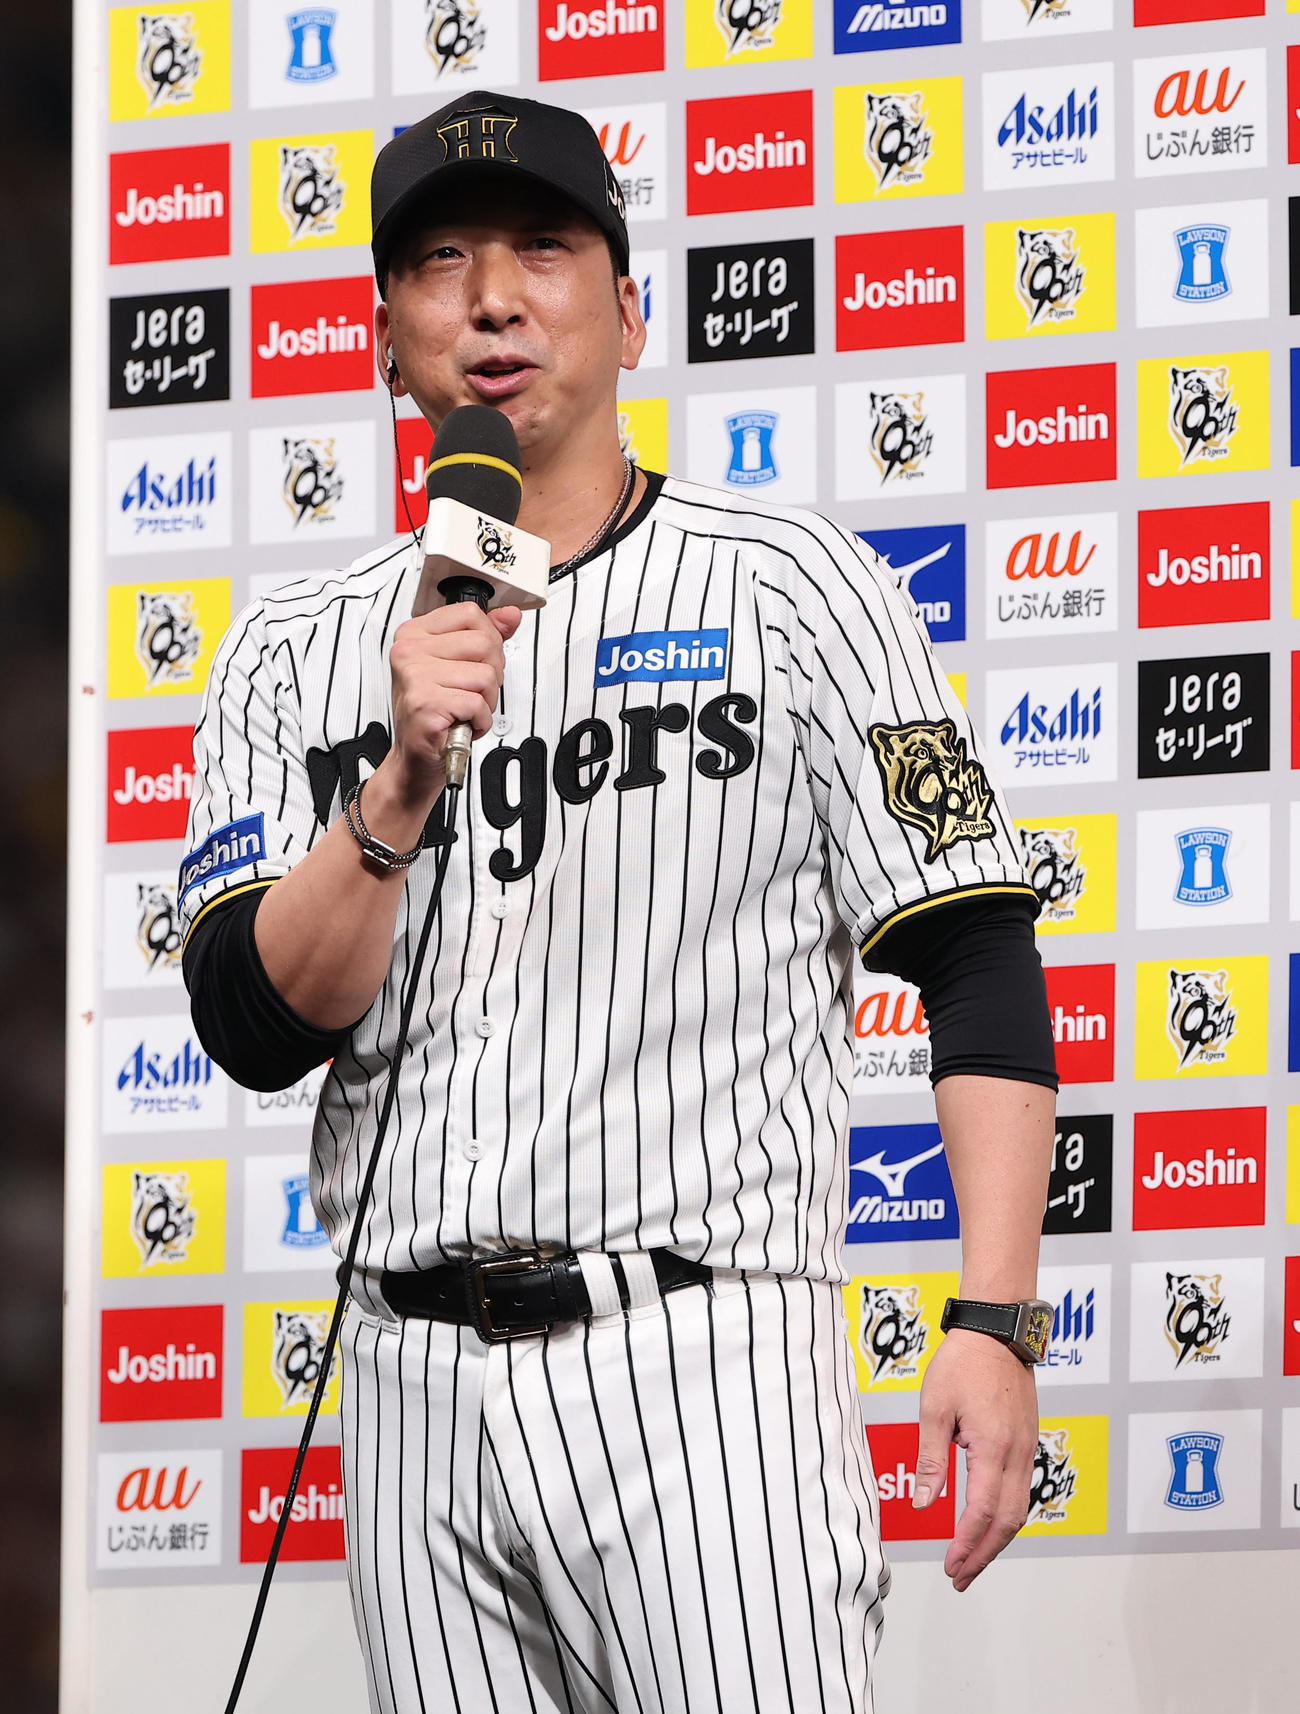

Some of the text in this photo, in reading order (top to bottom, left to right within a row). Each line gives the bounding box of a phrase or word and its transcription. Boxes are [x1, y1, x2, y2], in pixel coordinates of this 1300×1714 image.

[546, 0, 658, 41] Joshin
[1154, 67, 1245, 118] au
[998, 87, 1098, 147] Asahi
[600, 121, 646, 166] u
[694, 132, 805, 175] Joshin
[1012, 147, 1087, 169] アサヒビール
[1147, 125, 1254, 160] じぶん銀行
[116, 183, 224, 226] Joshin
[844, 267, 957, 310] Joshin
[258, 316, 367, 358] Joshin
[995, 405, 1108, 447] Joshin
[121, 456, 217, 512] Asahi
[1006, 531, 1097, 581] au
[1147, 544, 1262, 587] Joshin
[998, 588, 1105, 622] じぶん銀行
[598, 640, 725, 677] Joshin
[1000, 686, 1101, 745] Asahi
[1014, 747, 1090, 768] アサヒビール
[114, 763, 195, 804] Josh
[955, 820, 991, 834] Tigers
[1180, 832, 1228, 849] LAWSON
[179, 831, 260, 896] Joshin
[1180, 885, 1227, 901] STATION
[1053, 1005, 1106, 1043] hin
[1142, 1149, 1257, 1190] Joshin
[108, 1344, 216, 1383] Joshin
[1171, 1437, 1219, 1453] LAWSON
[117, 1466, 202, 1512] au
[1171, 1490, 1218, 1505] STATION
[108, 1523, 209, 1553] じぶん銀行
